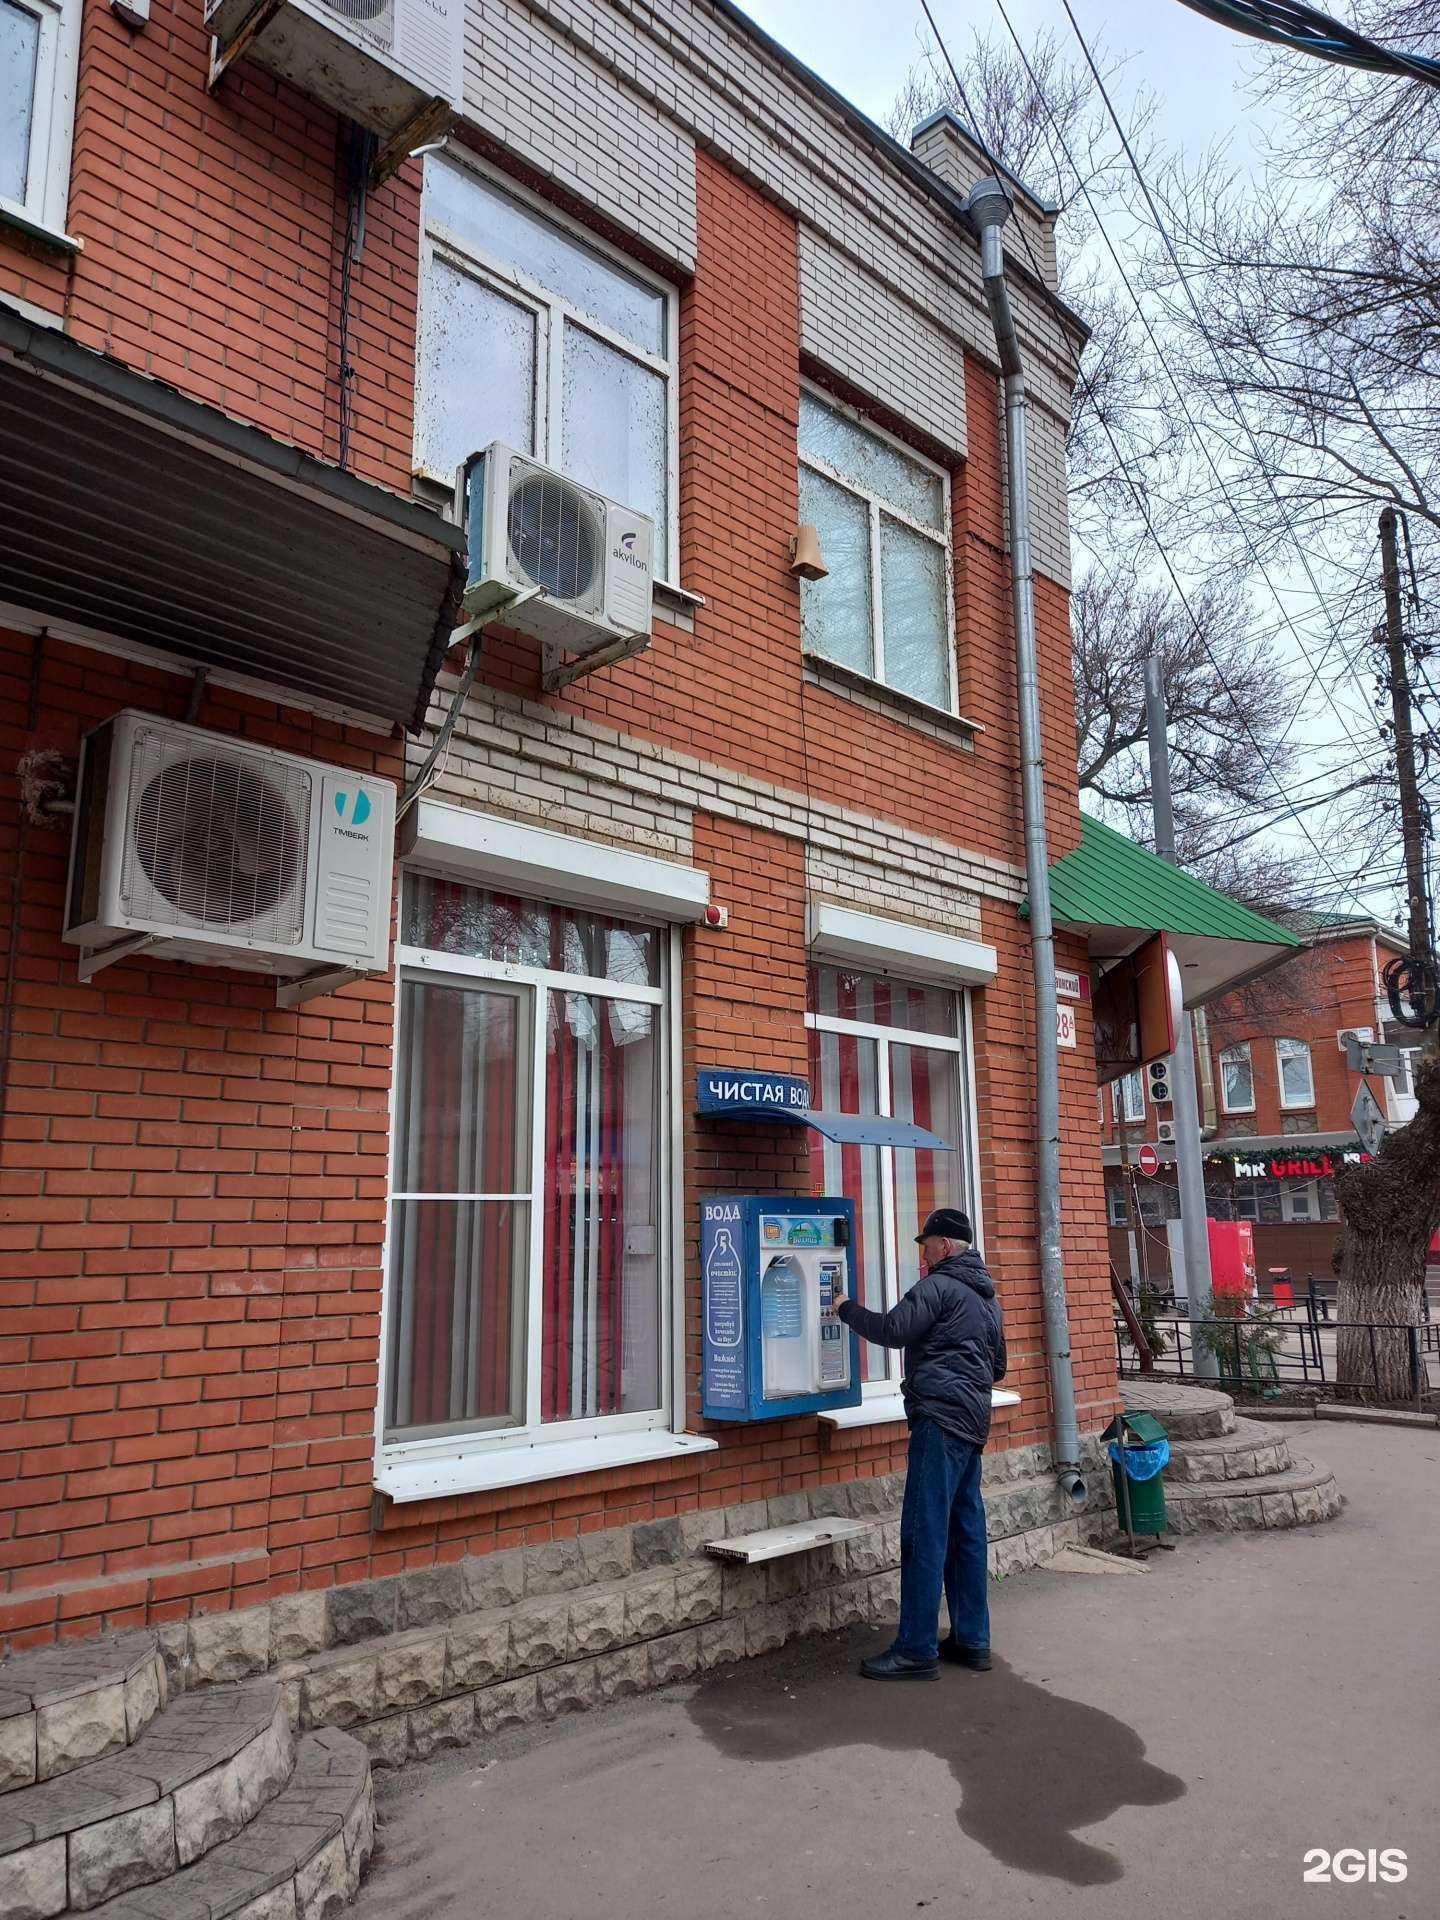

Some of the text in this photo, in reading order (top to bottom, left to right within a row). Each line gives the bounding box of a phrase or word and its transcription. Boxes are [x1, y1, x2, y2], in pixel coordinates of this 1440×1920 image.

[612, 548, 647, 571] akvilon
[333, 827, 369, 842] TIMBERK
[709, 1081, 784, 1103] ЧИСТАЯ
[1234, 1160, 1266, 1178] MR
[705, 1204, 741, 1222] ВОДА
